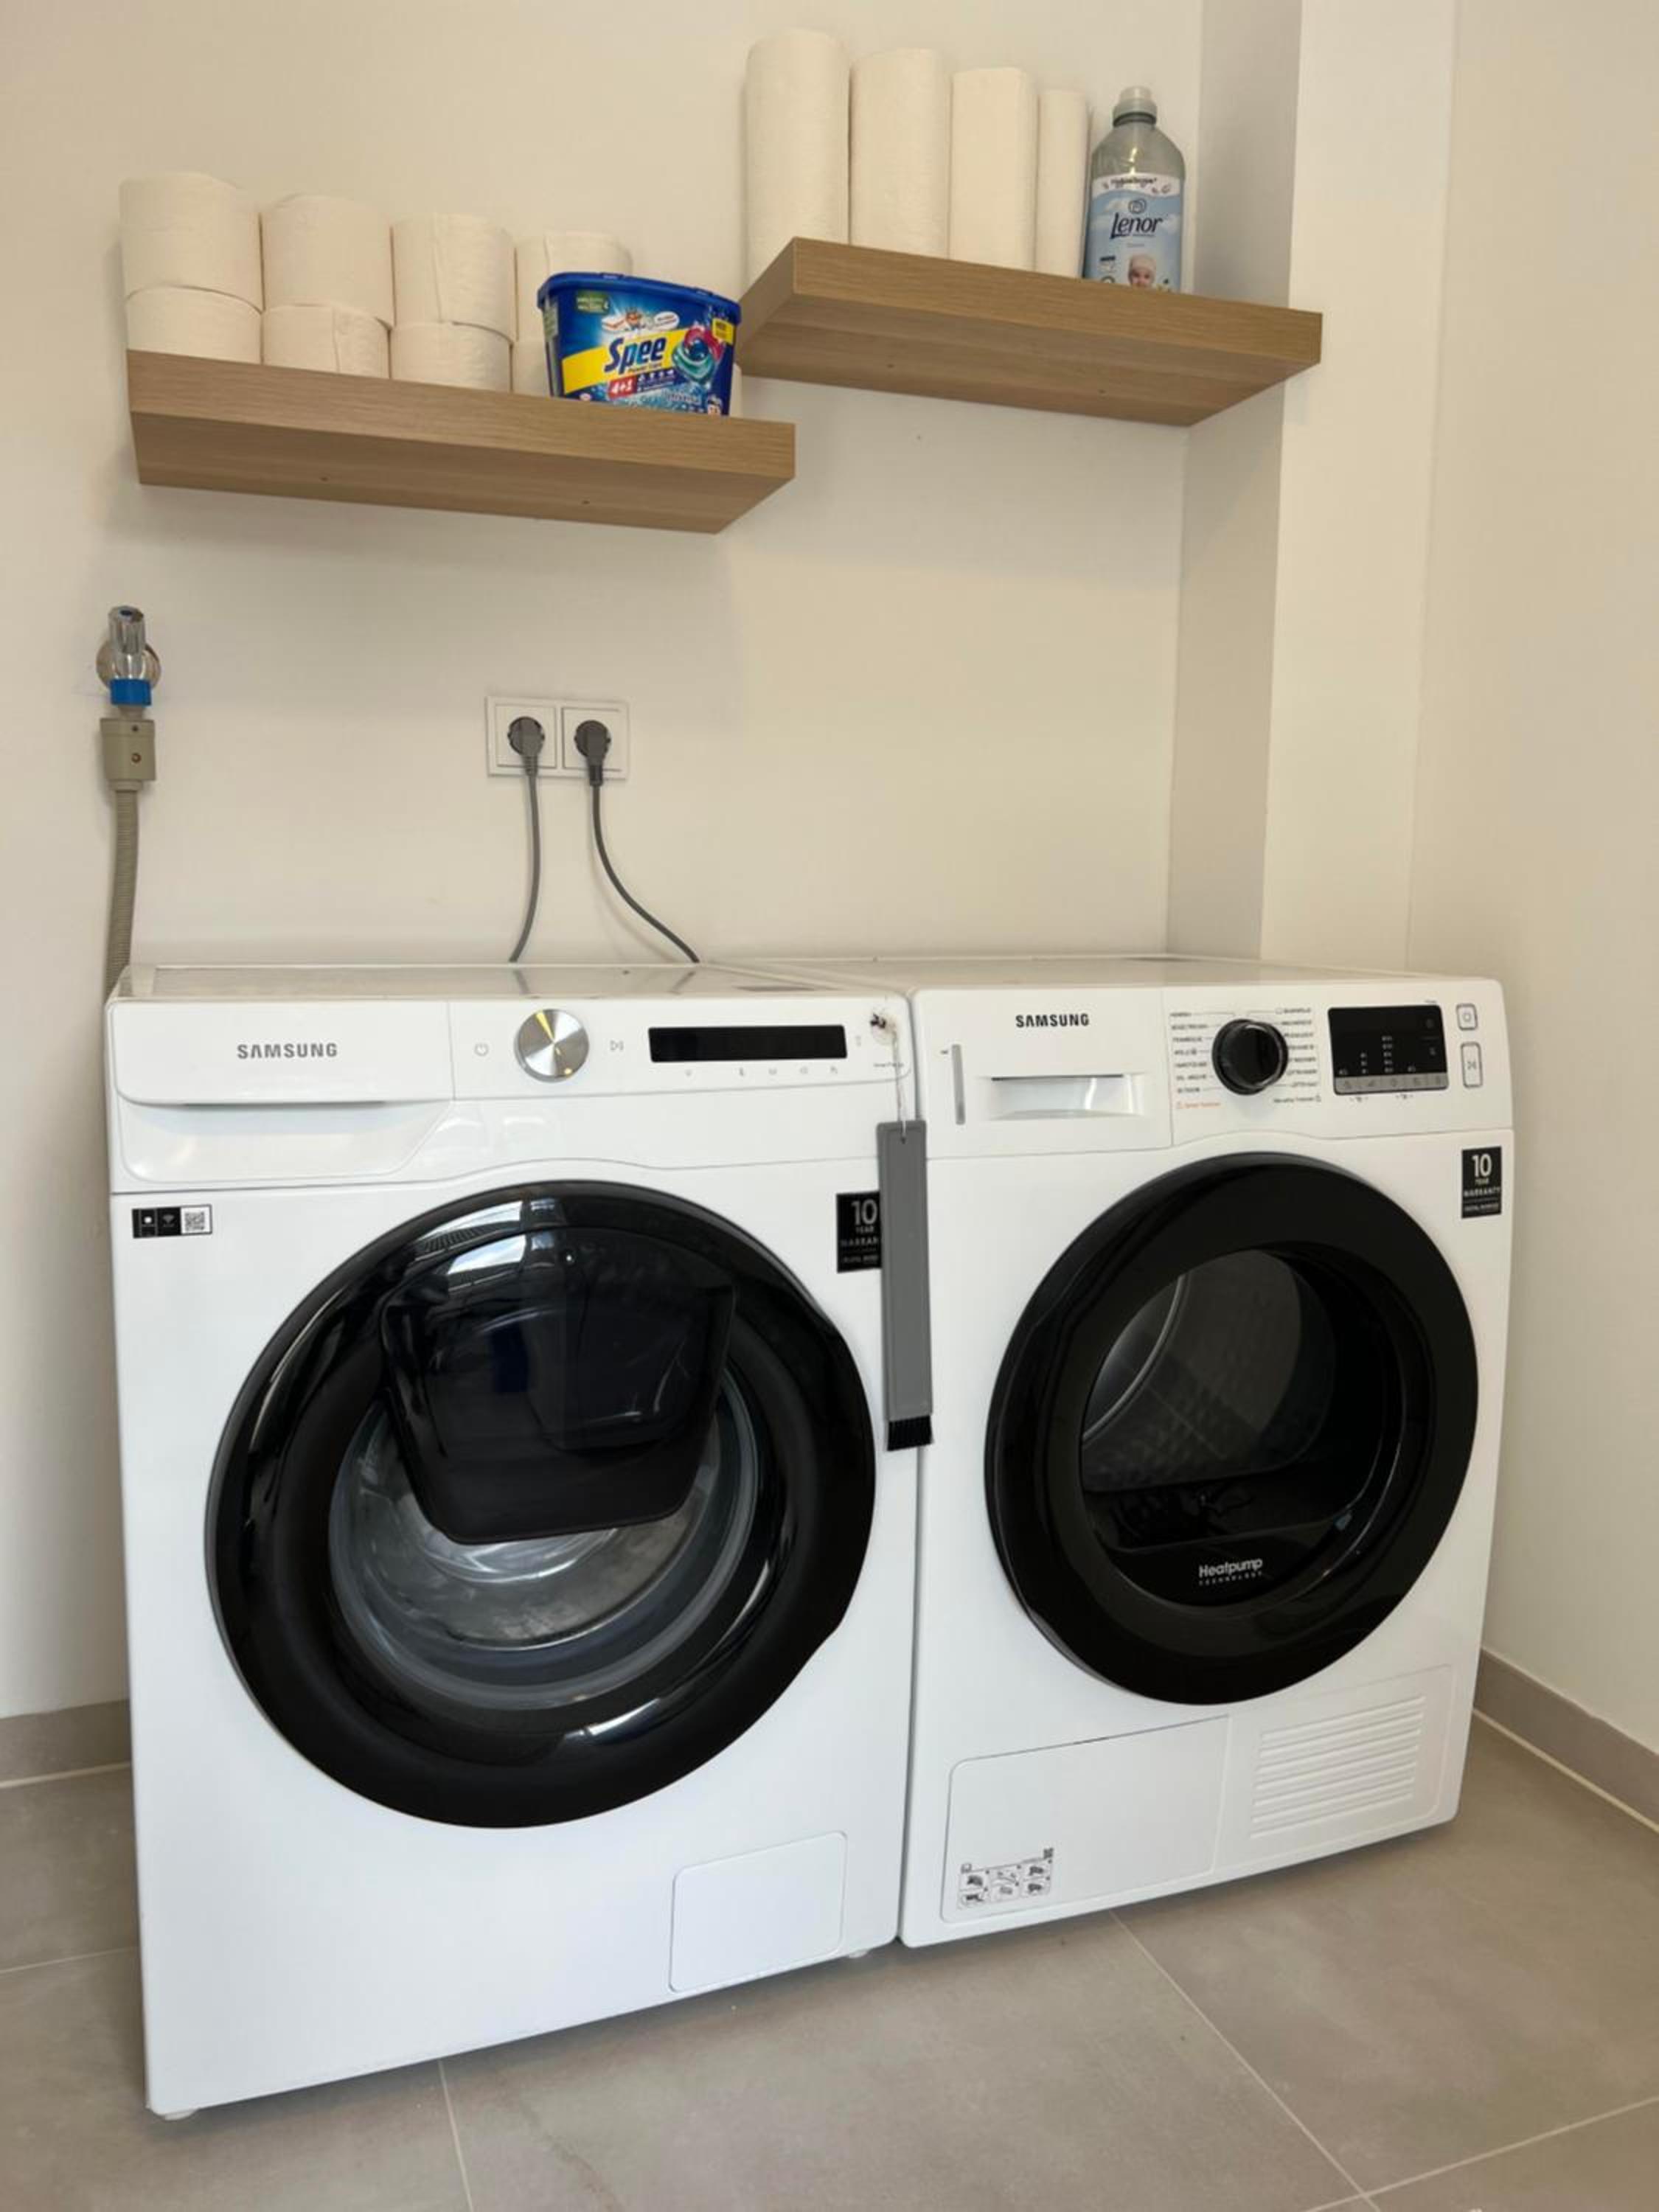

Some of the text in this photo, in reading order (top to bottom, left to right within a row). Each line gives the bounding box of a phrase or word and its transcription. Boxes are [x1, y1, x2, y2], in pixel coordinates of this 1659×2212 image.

[1110, 212, 1164, 240] Lenor
[604, 338, 667, 375] Spee
[611, 378, 633, 394] 4+1
[1015, 1013, 1089, 1028] SAMSUNG
[237, 1043, 338, 1059] SAMSUNG
[1472, 1153, 1492, 1178] 10
[851, 1199, 877, 1225] 10
[1199, 1558, 1263, 1578] Heatpump
